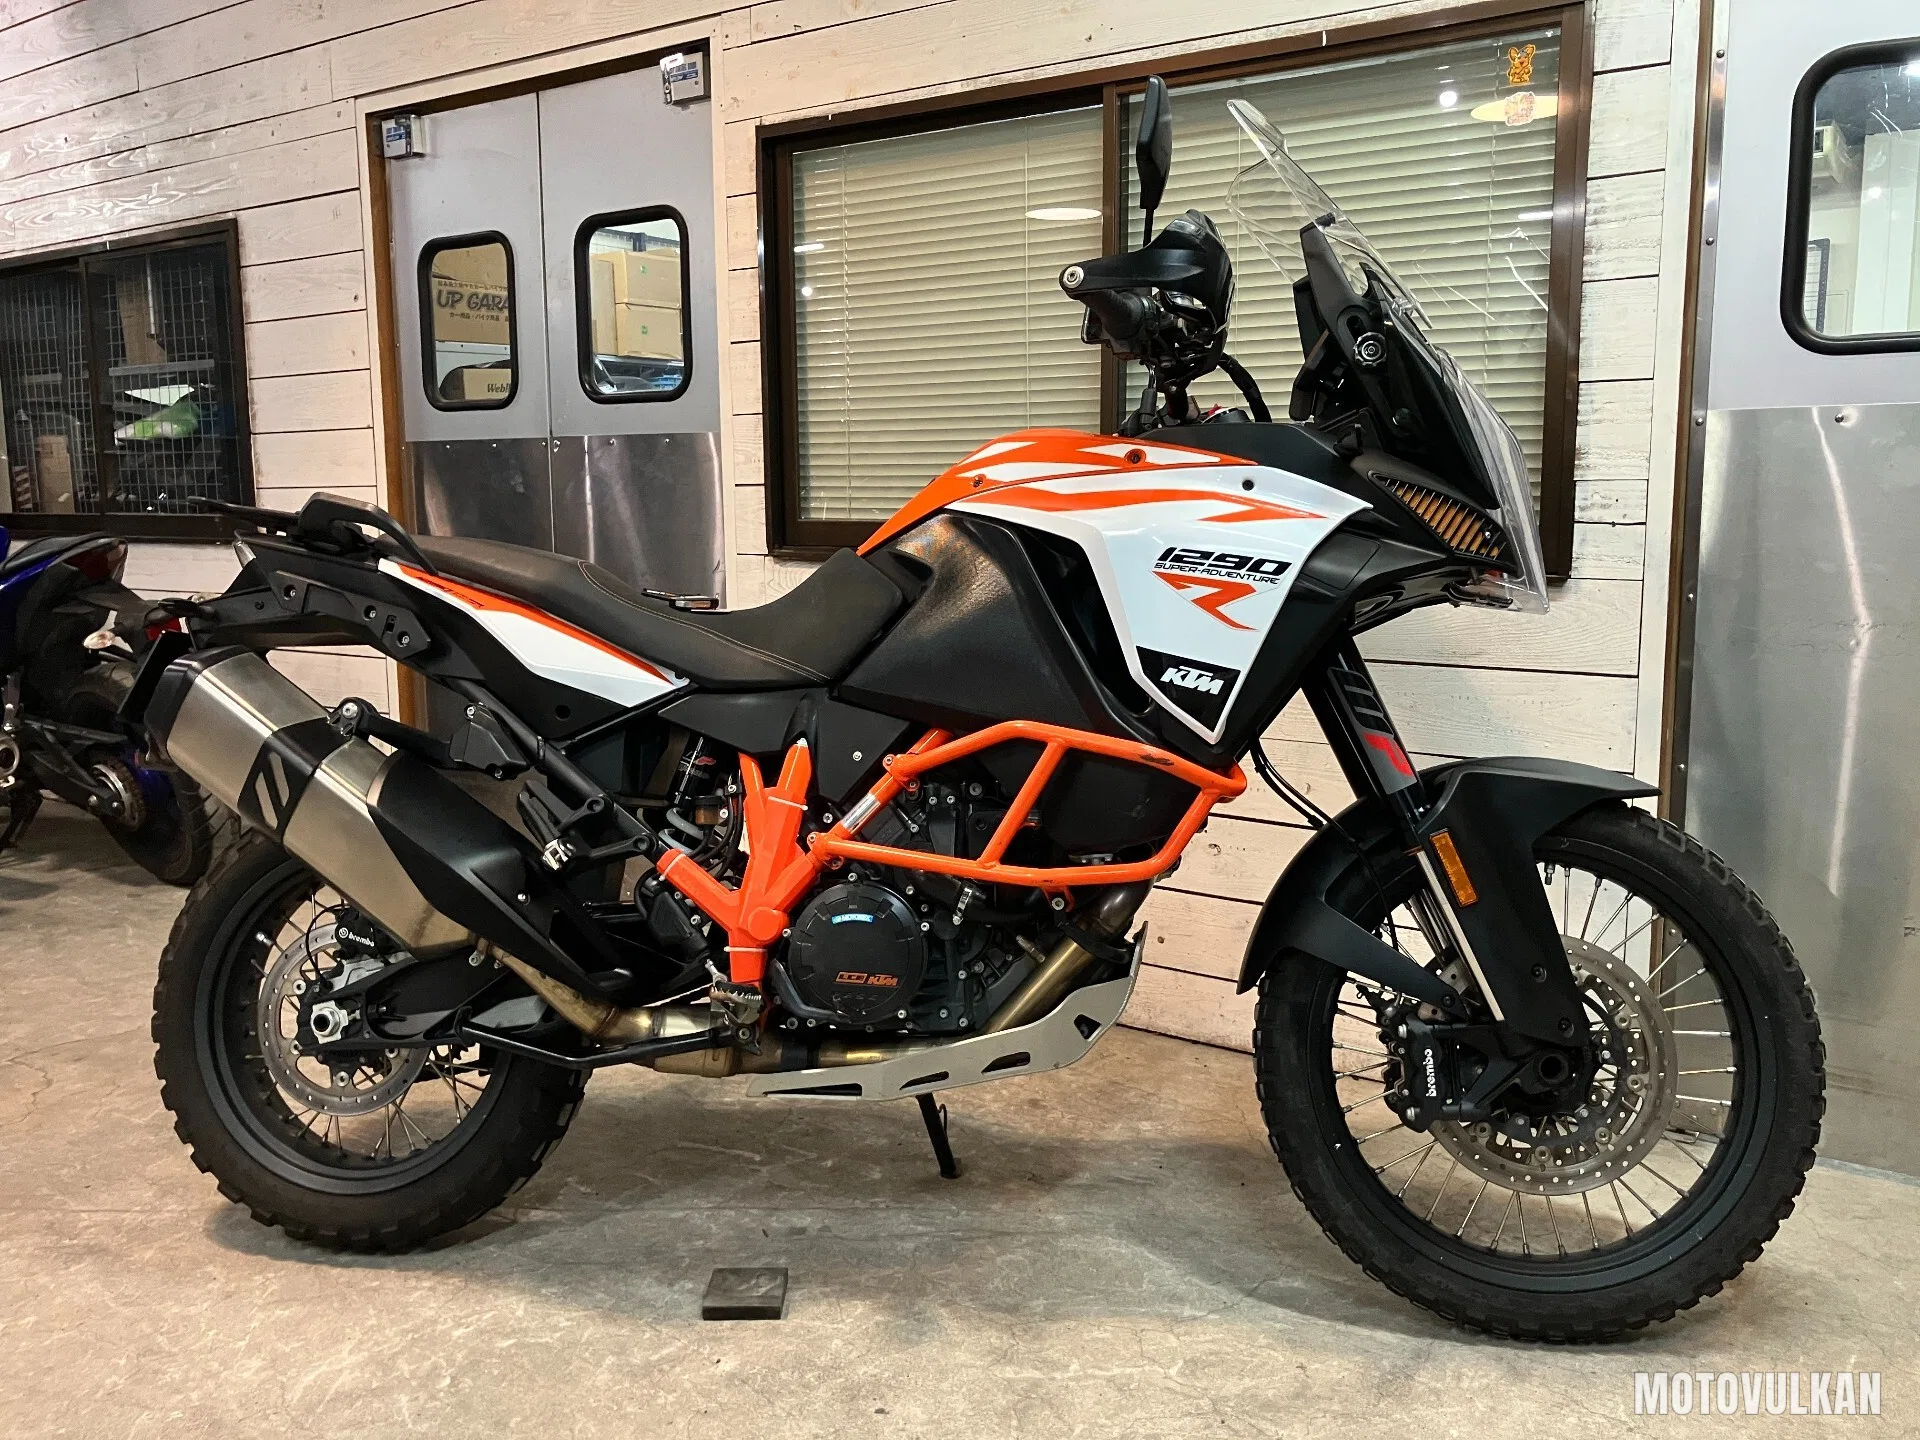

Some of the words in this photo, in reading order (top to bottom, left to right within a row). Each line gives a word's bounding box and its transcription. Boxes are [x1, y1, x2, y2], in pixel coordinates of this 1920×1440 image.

[437, 289, 463, 309] UP
[1154, 562, 1281, 585] SUPER-ADVENTURE
[1157, 546, 1293, 577] 1290
[1151, 570, 1258, 631] R
[1159, 665, 1225, 695] KTM
[349, 931, 375, 947] brembo
[867, 974, 898, 986] KTM
[1423, 1048, 1437, 1097] brembo
